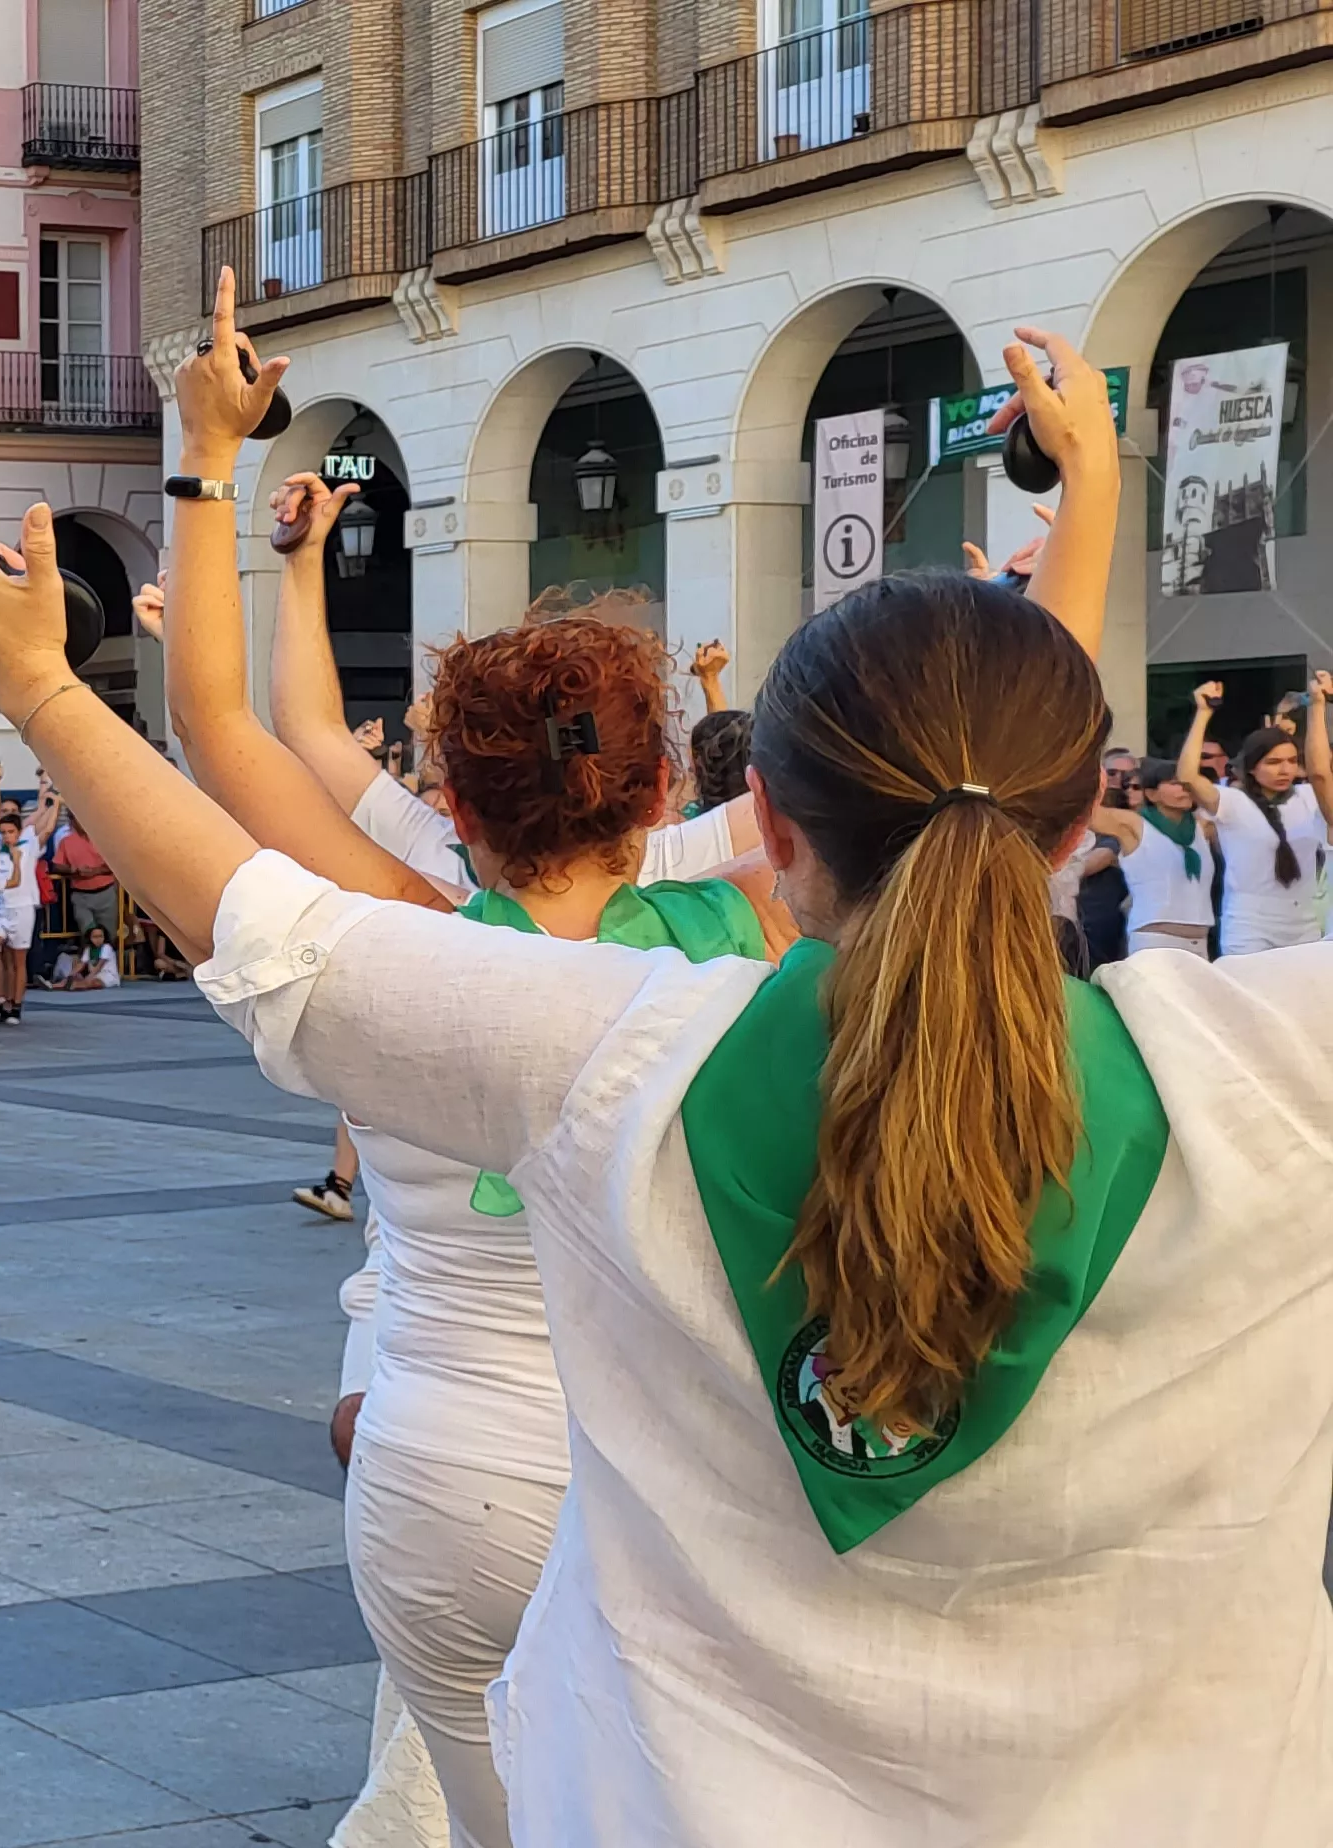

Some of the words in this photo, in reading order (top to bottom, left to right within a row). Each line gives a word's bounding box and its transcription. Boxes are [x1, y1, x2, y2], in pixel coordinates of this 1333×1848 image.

[945, 399, 977, 421] YO
[978, 390, 1011, 415] NO
[1219, 394, 1273, 424] HUESCA
[829, 433, 878, 451] Oficina
[860, 451, 878, 465] de
[822, 471, 877, 489] Turismo
